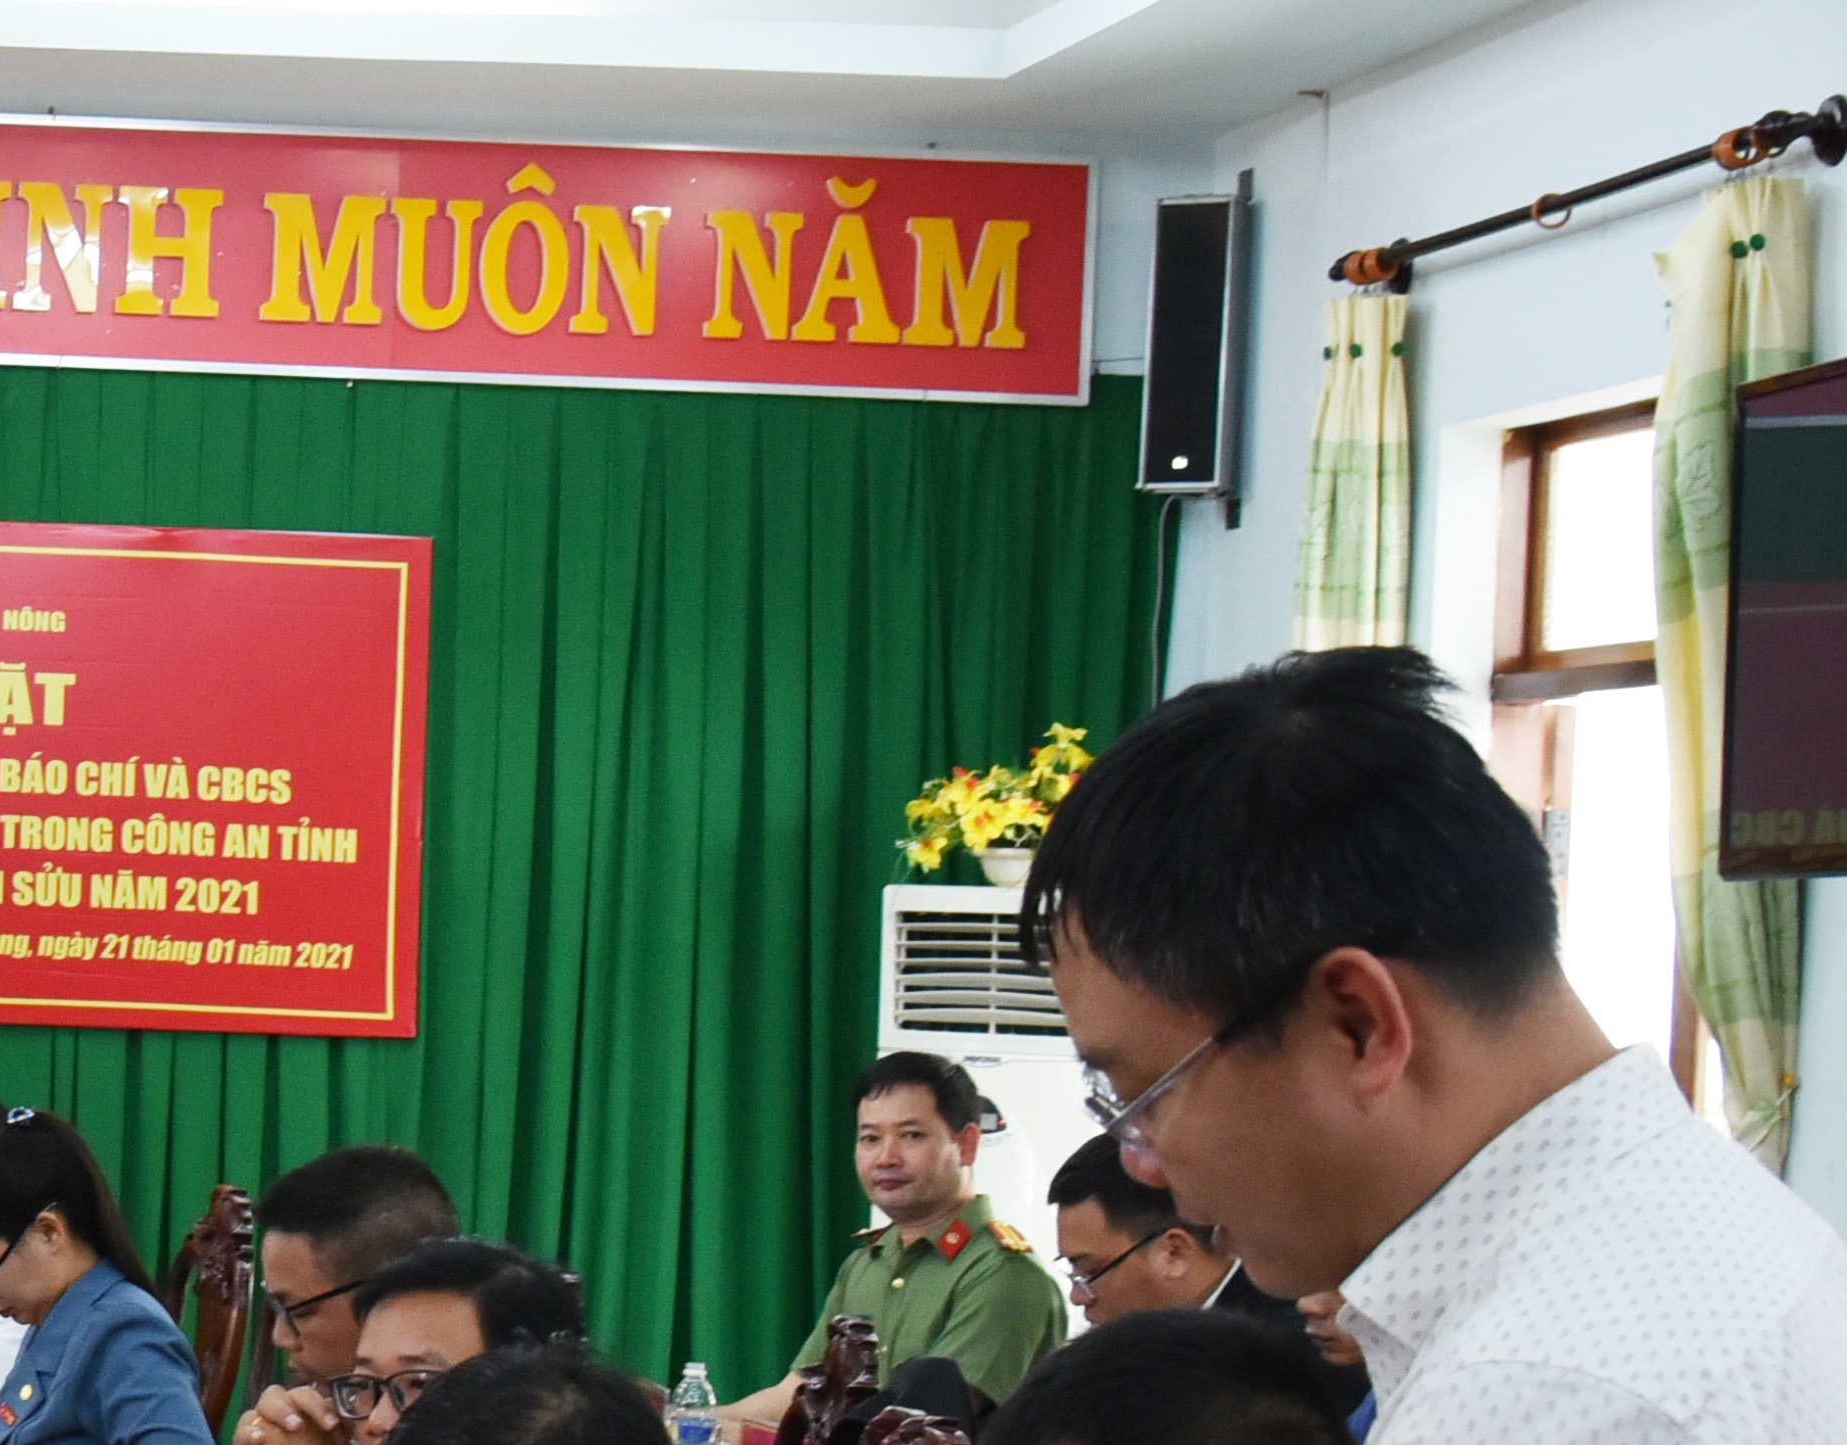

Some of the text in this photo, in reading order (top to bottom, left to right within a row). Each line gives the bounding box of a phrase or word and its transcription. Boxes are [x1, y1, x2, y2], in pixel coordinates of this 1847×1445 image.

[260, 163, 670, 338] MUÔN
[705, 177, 1030, 350] NĂM
[2, 605, 67, 633] NÔNG
[75, 755, 141, 798] CHÍ
[144, 757, 190, 800] VÀ
[196, 765, 292, 805] CBCS
[121, 812, 216, 858] CÔNG
[222, 823, 270, 860] AN
[276, 816, 358, 864] TỈNH
[11, 861, 83, 908] SỬU
[89, 869, 168, 911] NĂM
[174, 876, 259, 916] 2021
[36, 931, 102, 960] ngày
[102, 934, 131, 960] 21
[131, 934, 204, 966] tháng
[206, 937, 236, 964] 01
[236, 939, 293, 967] năm
[294, 941, 354, 970] 2021
